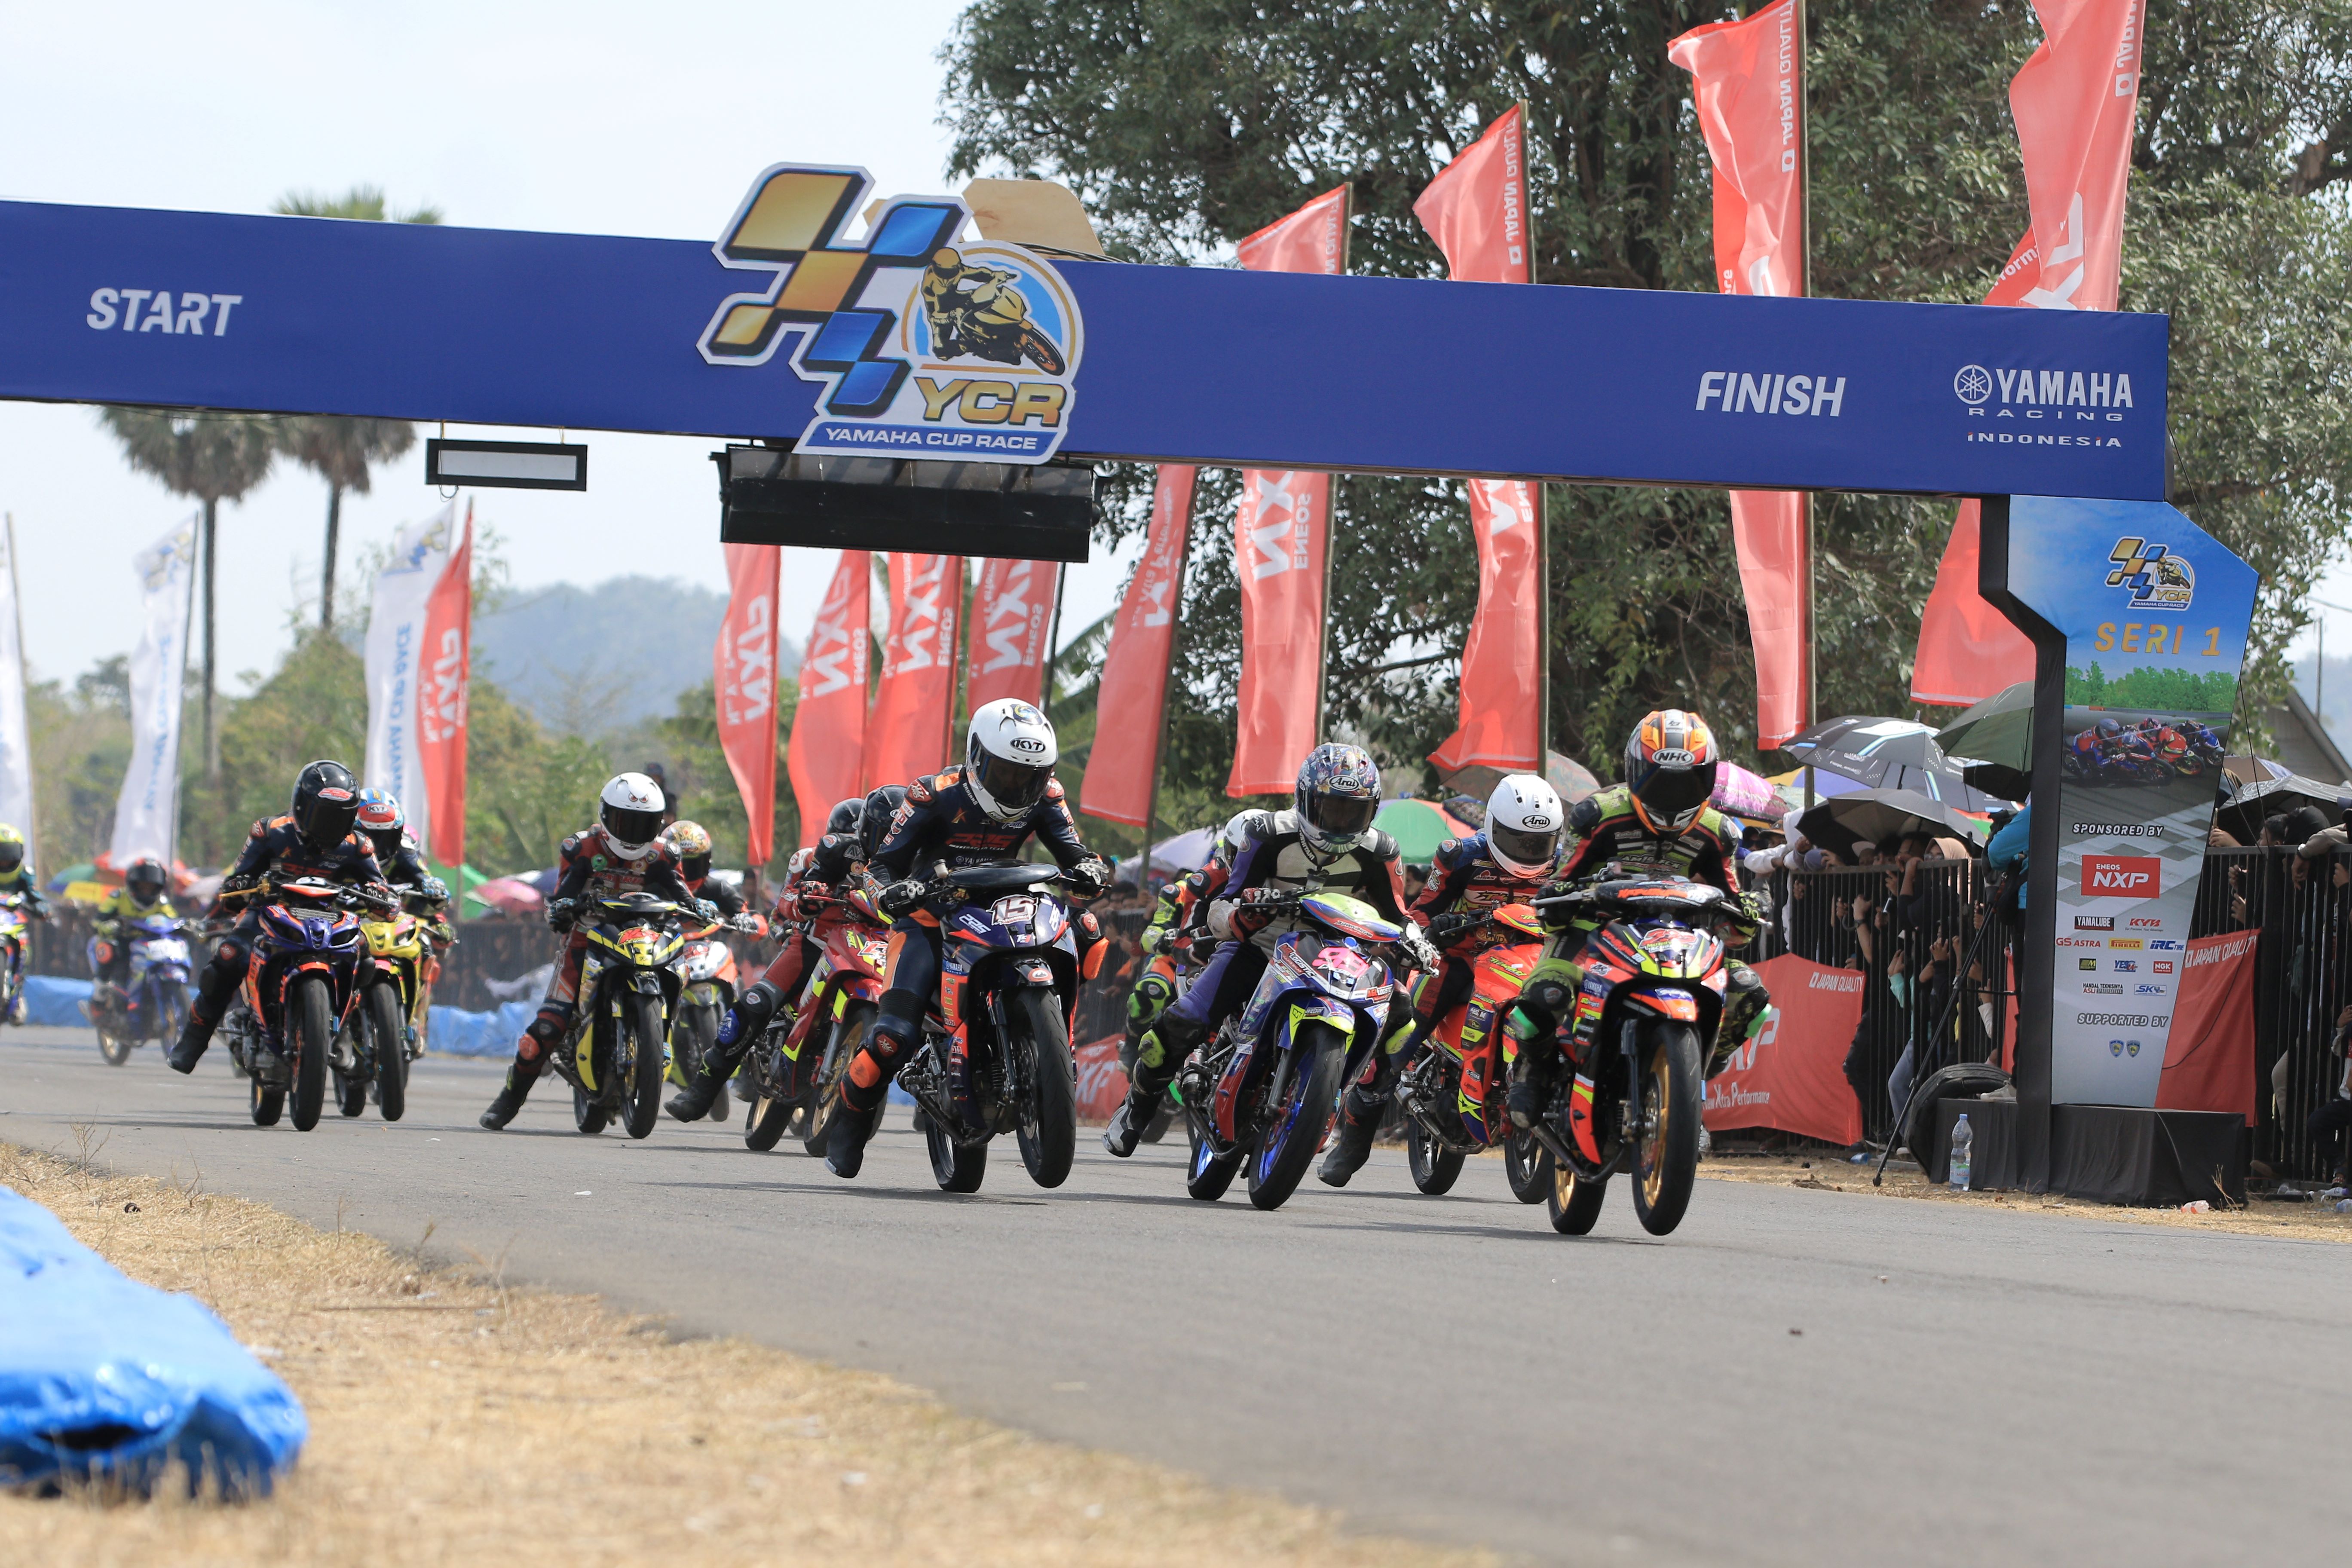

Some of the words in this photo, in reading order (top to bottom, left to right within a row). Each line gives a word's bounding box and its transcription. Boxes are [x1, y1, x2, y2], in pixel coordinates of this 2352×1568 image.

[87, 287, 243, 337] START
[1695, 371, 1846, 417] FINISH
[1995, 368, 2133, 408] YAMAHA
[915, 377, 1065, 427] YCR
[1968, 407, 2122, 422] RACING
[826, 428, 922, 445] YAMAHA
[926, 432, 973, 447] CUP
[976, 435, 1038, 450] RACE
[2154, 589, 2192, 602] YCR
[2094, 622, 2184, 654] SERI
[2201, 627, 2220, 656] 1
[1013, 739, 1044, 751] KYT
[1657, 752, 1689, 761] NHK
[1332, 777, 1356, 787] Arai
[1525, 817, 1548, 826] Arai
[2073, 823, 2144, 836] SPONSORED
[2147, 826, 2164, 837] BY
[2092, 871, 2149, 888] NXP
[2077, 916, 2110, 927] YAMALUBE
[2129, 918, 2161, 927] KYB
[2055, 937, 2072, 946] GS
[2073, 940, 2101, 948] ASTRA
[2193, 945, 2221, 966] JAPAN
[949, 962, 962, 972] YAMAHA
[1289, 952, 1317, 977] LOGISTIC
[1816, 973, 1838, 991] JAPAN
[1838, 975, 1864, 993] QUALITY
[1366, 989, 1378, 998] AGL
[2077, 1013, 2149, 1026] SUPPORTED
[2151, 1016, 2168, 1027] BY
[1713, 1084, 1731, 1108] Xtra
